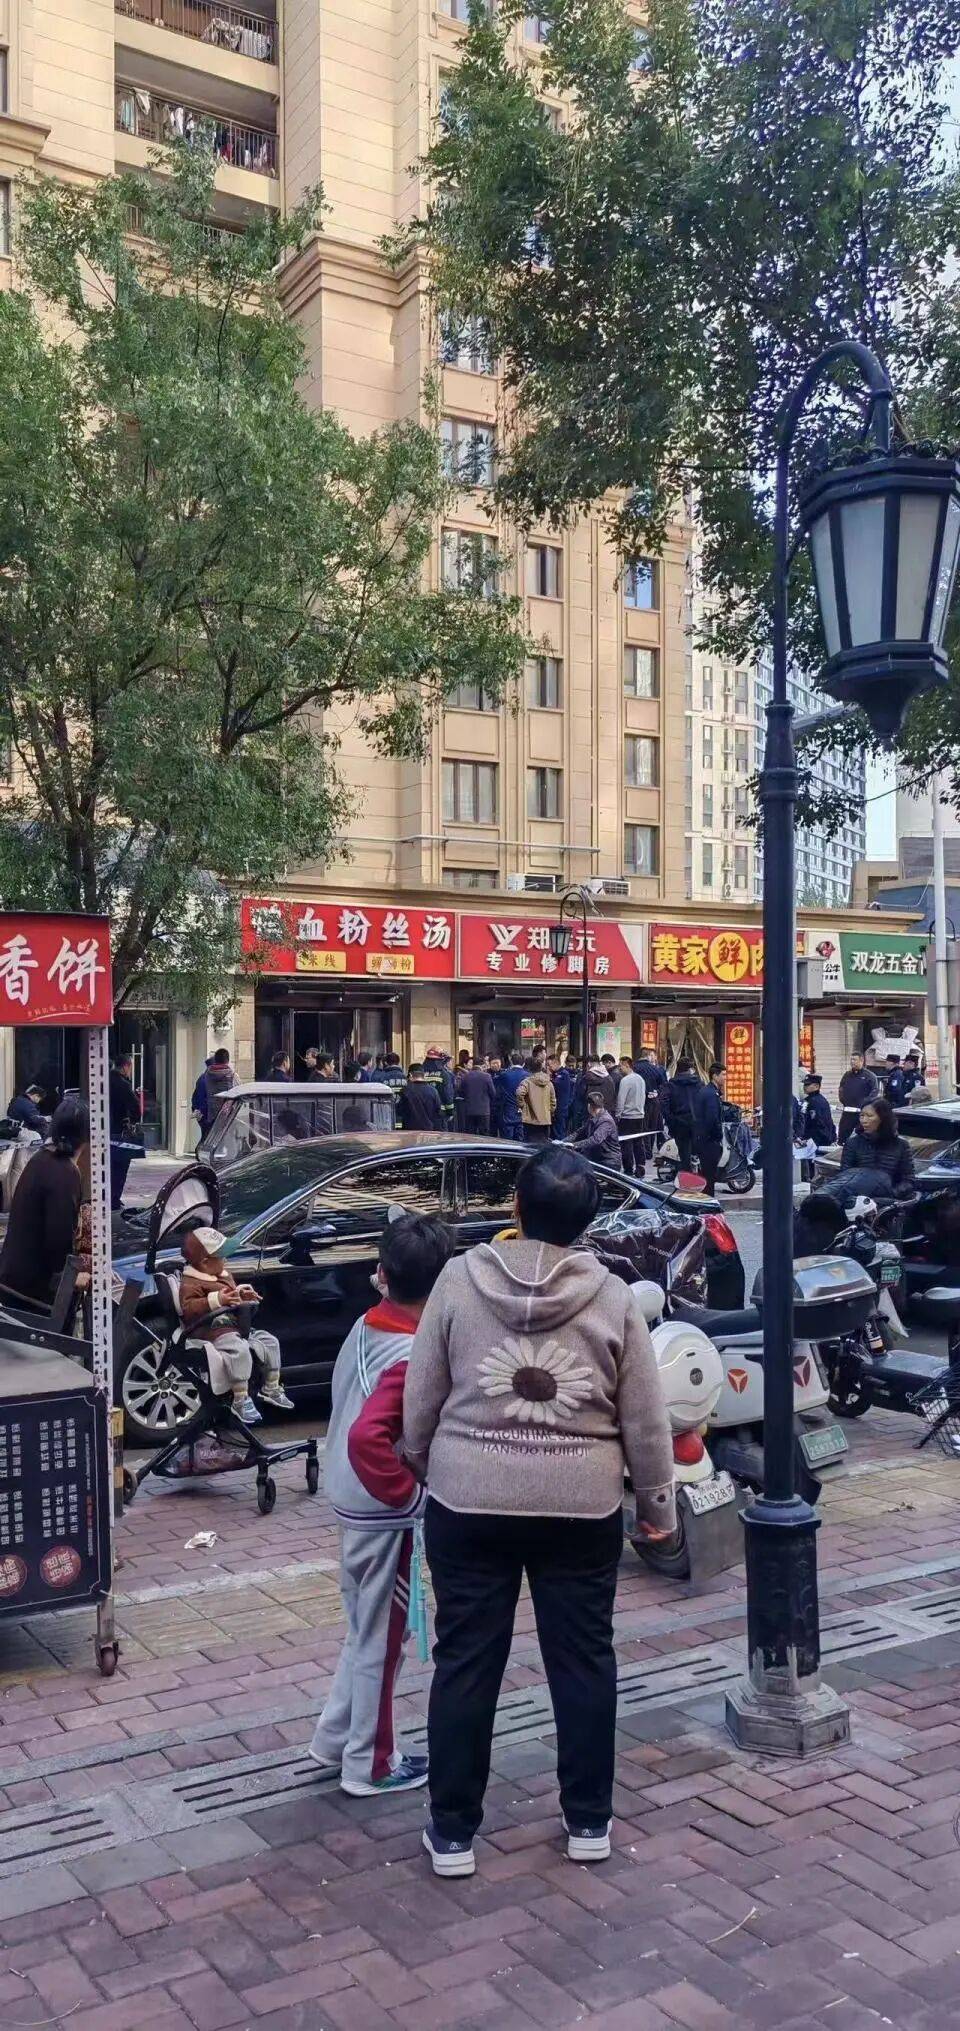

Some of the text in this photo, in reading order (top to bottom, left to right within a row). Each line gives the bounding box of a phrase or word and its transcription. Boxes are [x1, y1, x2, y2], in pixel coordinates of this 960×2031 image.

[249, 904, 451, 949] 血粉丝汤
[528, 927, 596, 952] 郑元
[0, 934, 106, 1006] 香饼
[486, 951, 610, 975] 专业修脚房
[825, 963, 841, 973] 公牛
